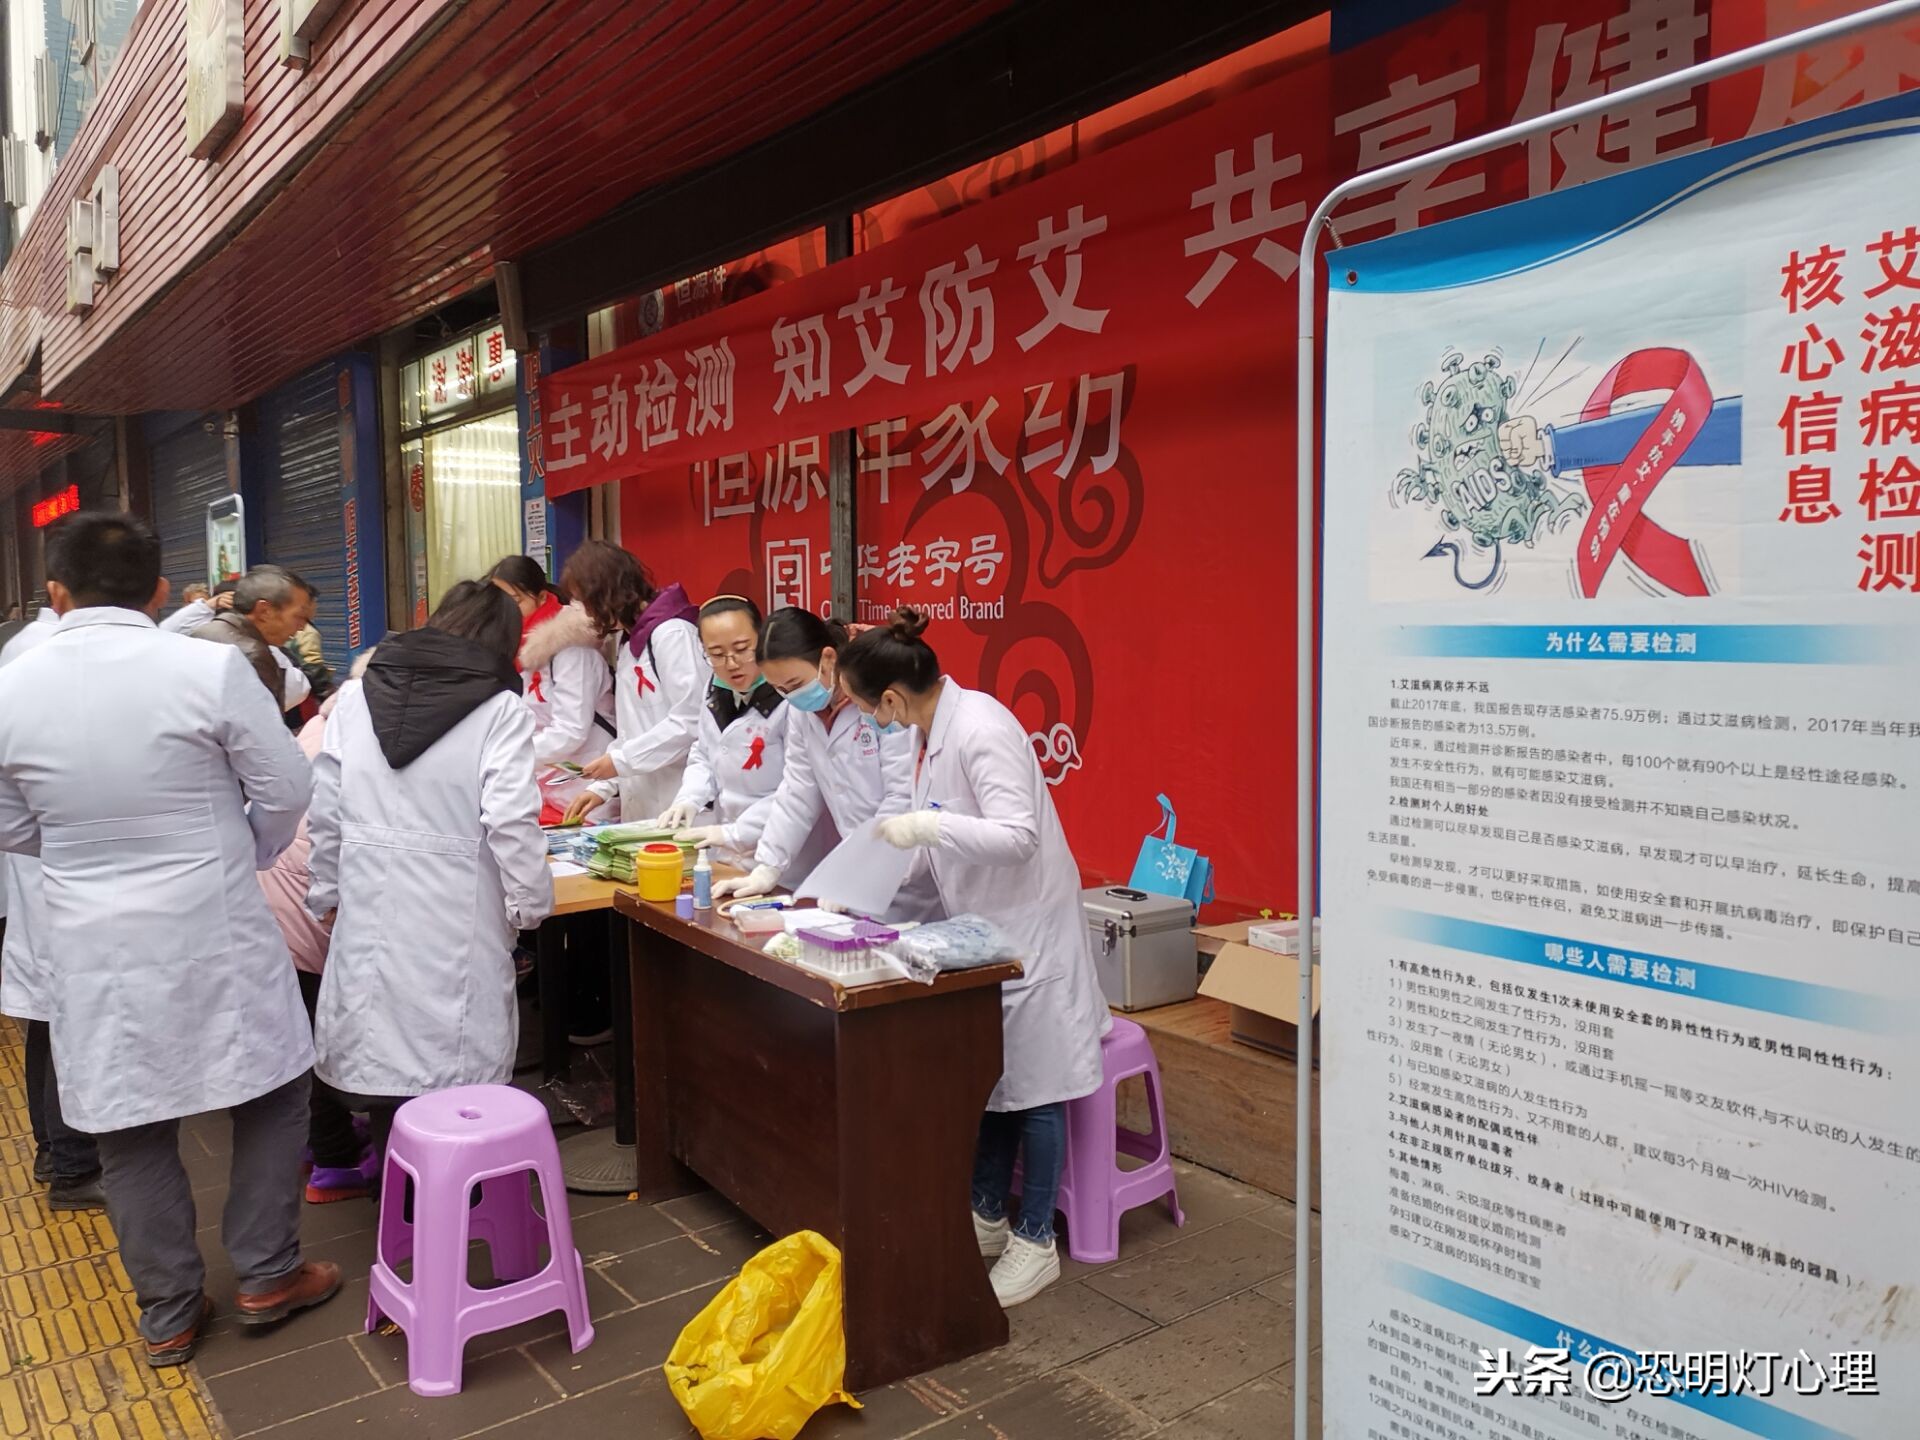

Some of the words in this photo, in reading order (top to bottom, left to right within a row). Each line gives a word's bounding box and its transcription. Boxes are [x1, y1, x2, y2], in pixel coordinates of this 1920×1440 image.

[546, 337, 736, 473] 主动检测
[772, 205, 1110, 415] 知艾防艾
[1779, 246, 1847, 524] 核心信息
[1857, 227, 1920, 593] 艾滋病检测
[1451, 455, 1512, 519] AIDS
[960, 595, 1004, 620] Brand
[1545, 631, 1698, 655] 为什么需要检测
[1544, 941, 1697, 990] 哪些人需要检测
